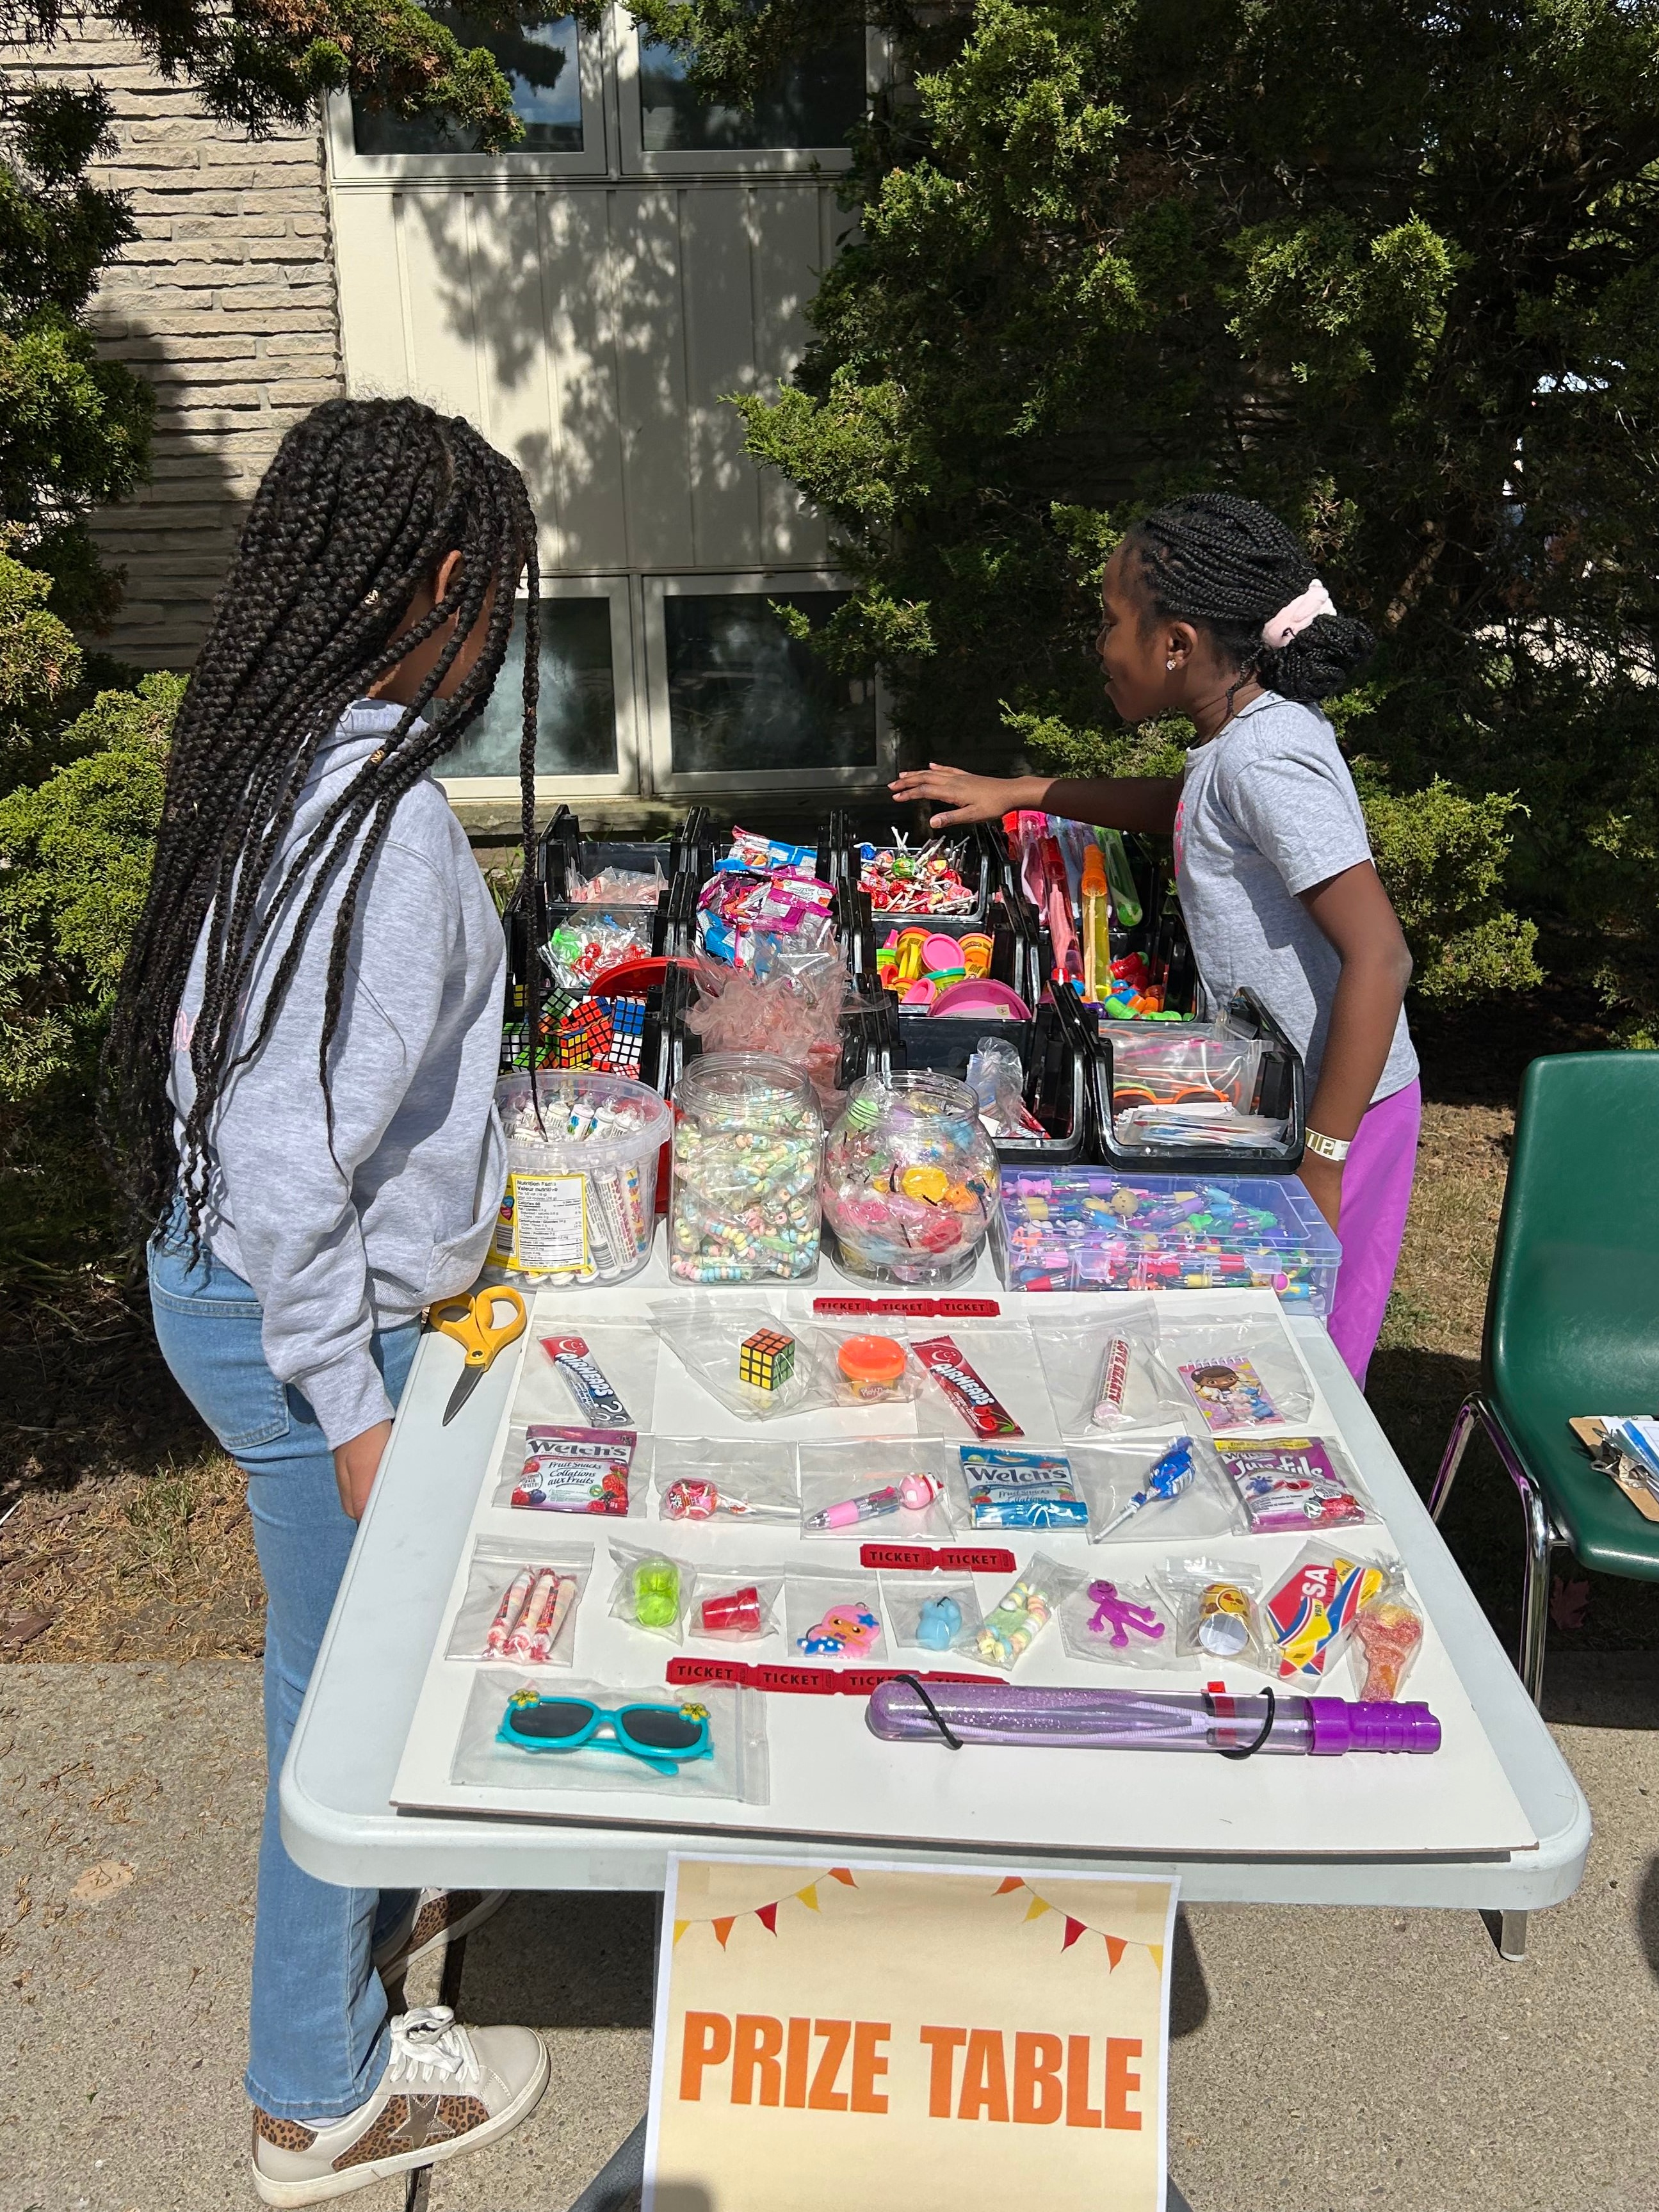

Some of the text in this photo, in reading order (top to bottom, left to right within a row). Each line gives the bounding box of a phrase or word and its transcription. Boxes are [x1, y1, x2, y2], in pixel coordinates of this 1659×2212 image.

[944, 1303, 985, 1311] TICKET
[554, 1353, 614, 1397] AIRHEADS
[930, 1363, 995, 1405] AIRHEADS
[528, 1441, 626, 1456] Welch's
[549, 1469, 596, 1478] Collations
[566, 1476, 594, 1485] Fruits
[966, 1467, 1067, 1483] Welch's
[870, 1551, 998, 1565] TICKET TICKET
[1301, 1569, 1329, 1601] SA
[677, 1665, 896, 1686] TICKET TICKET TICK
[679, 2010, 1143, 2131] PRIZE TABLE
